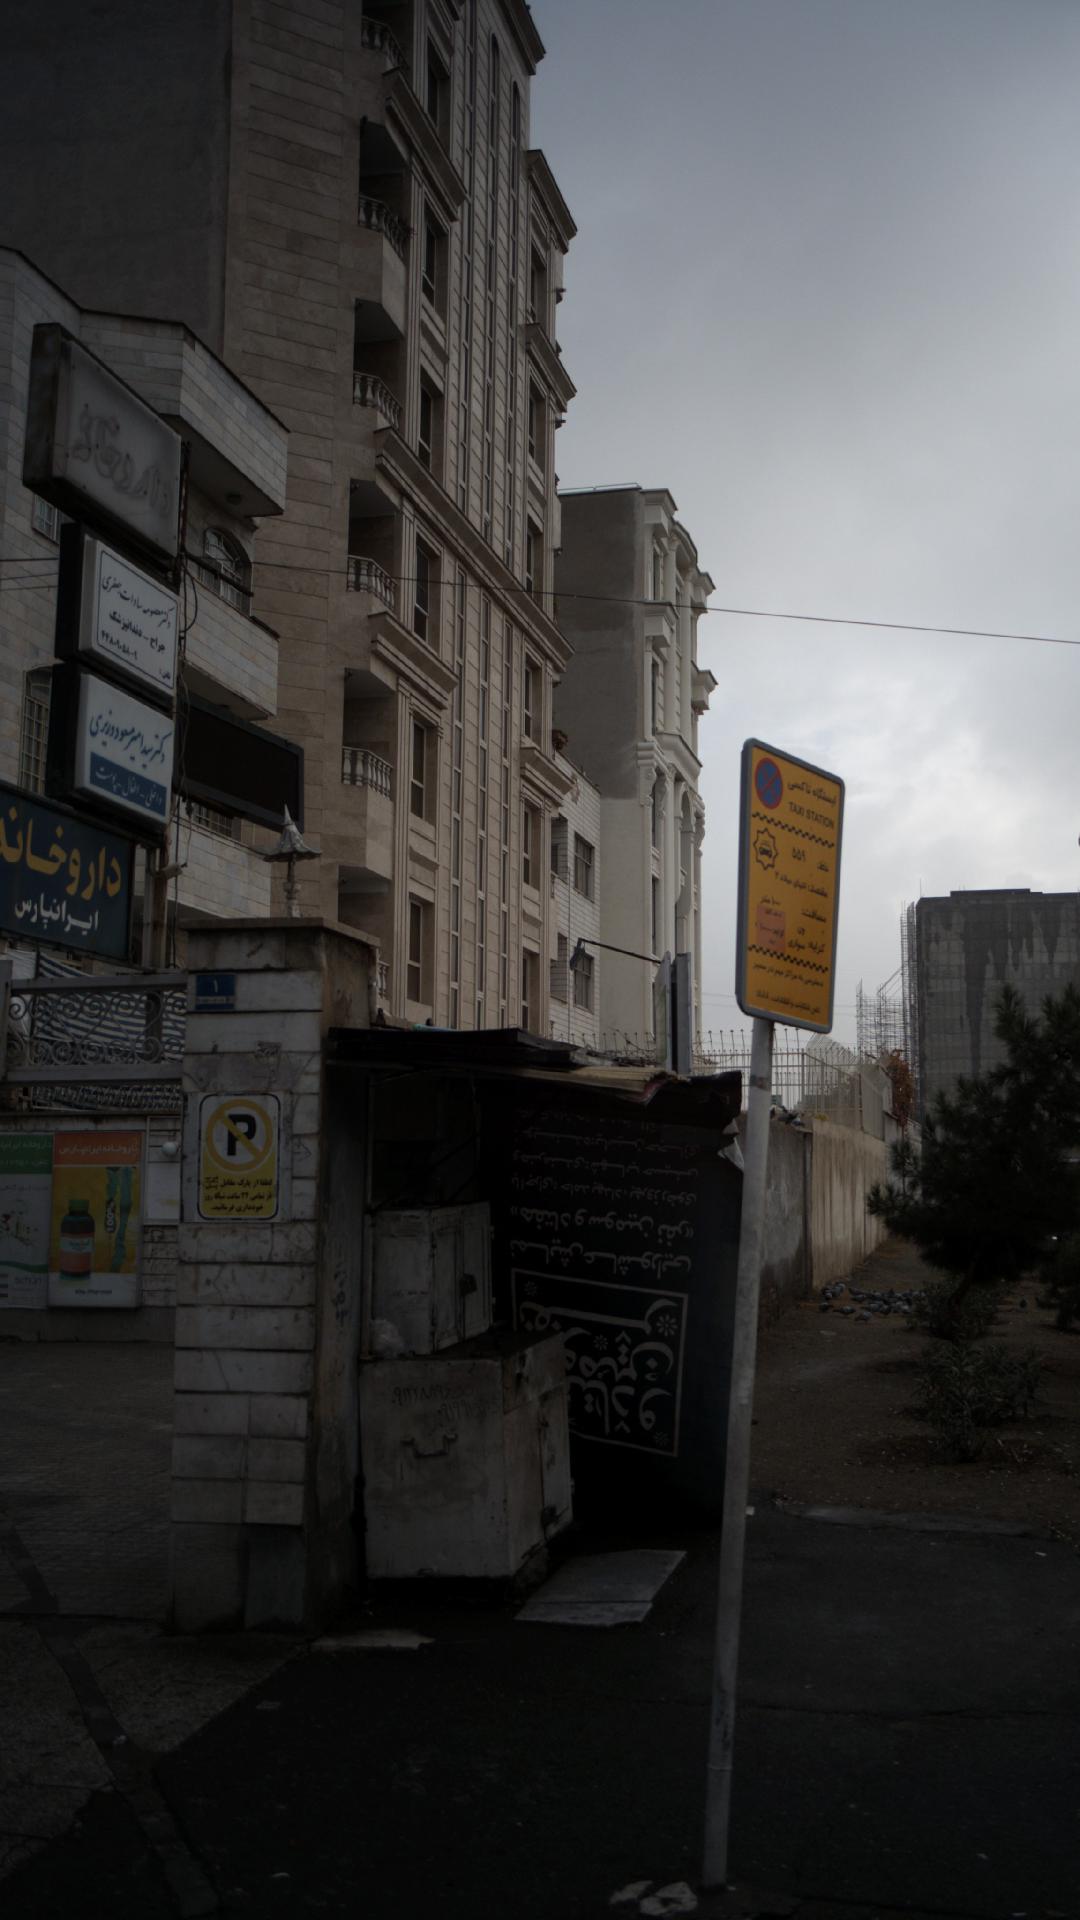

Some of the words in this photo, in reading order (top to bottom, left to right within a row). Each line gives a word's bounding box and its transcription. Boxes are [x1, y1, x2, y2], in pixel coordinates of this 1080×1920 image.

[150, 637, 165, 653] جراح
[149, 730, 173, 764] دکتر
[788, 801, 804, 816] TAXI
[806, 809, 835, 829] STATION
[587, 1211, 656, 1239] سومین
[509, 1237, 584, 1269] نمایش
